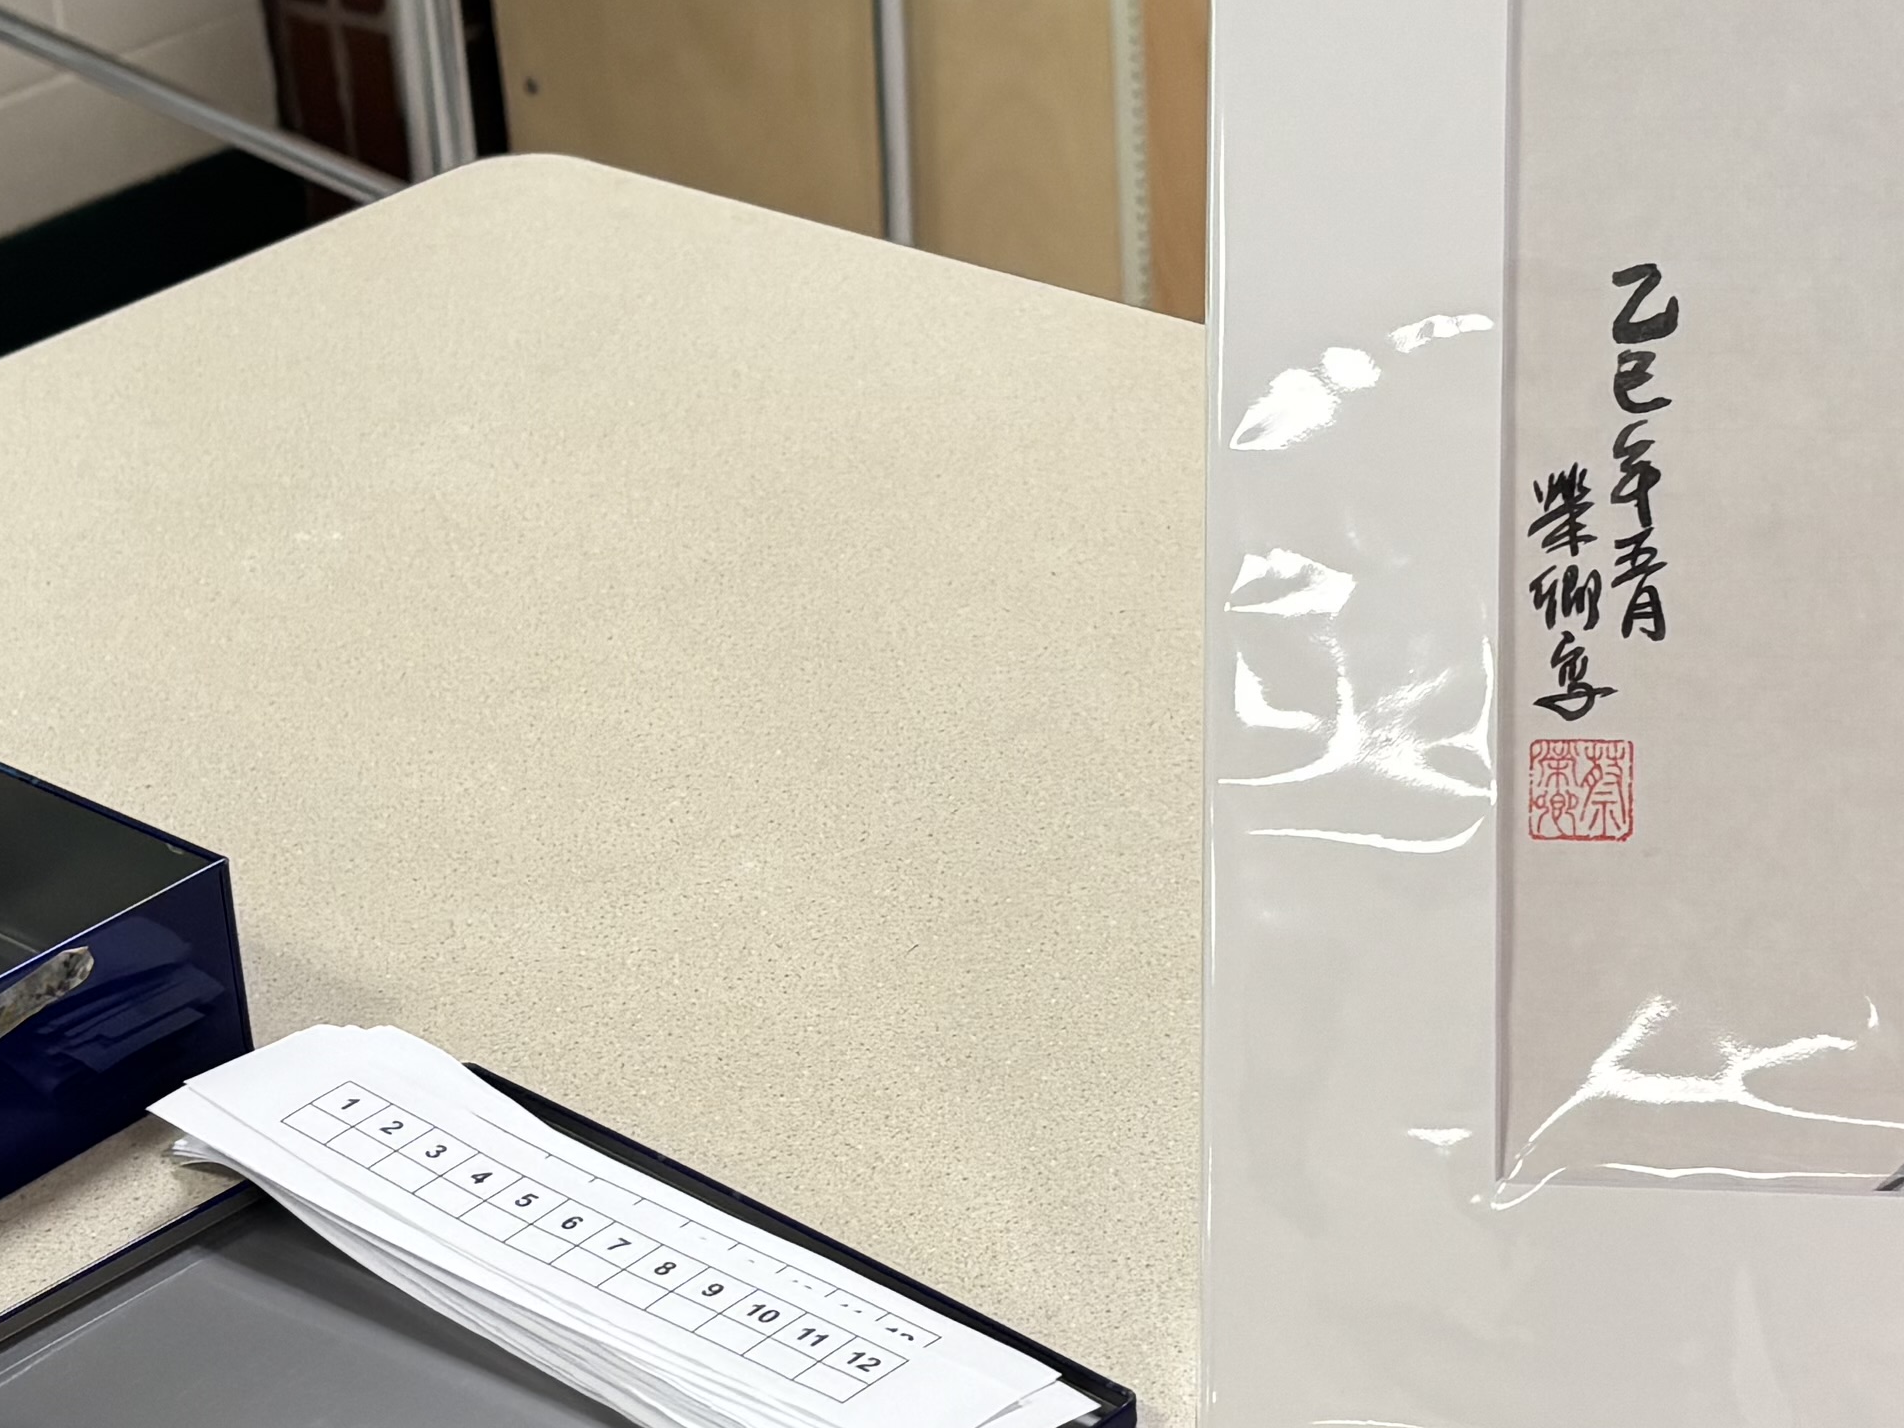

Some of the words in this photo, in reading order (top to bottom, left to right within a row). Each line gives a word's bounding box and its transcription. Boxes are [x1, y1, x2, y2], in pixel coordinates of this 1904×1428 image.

[341, 1098, 361, 1110] 1
[379, 1120, 404, 1135] 2
[425, 1144, 448, 1159] 3
[470, 1171, 493, 1184] 4
[514, 1193, 539, 1207] 5
[560, 1216, 584, 1230] 6
[607, 1237, 632, 1251] 7
[653, 1261, 677, 1276] 8
[701, 1283, 725, 1297] 9
[746, 1304, 780, 1323] 10
[796, 1327, 829, 1347] 11
[846, 1351, 881, 1373] 12
